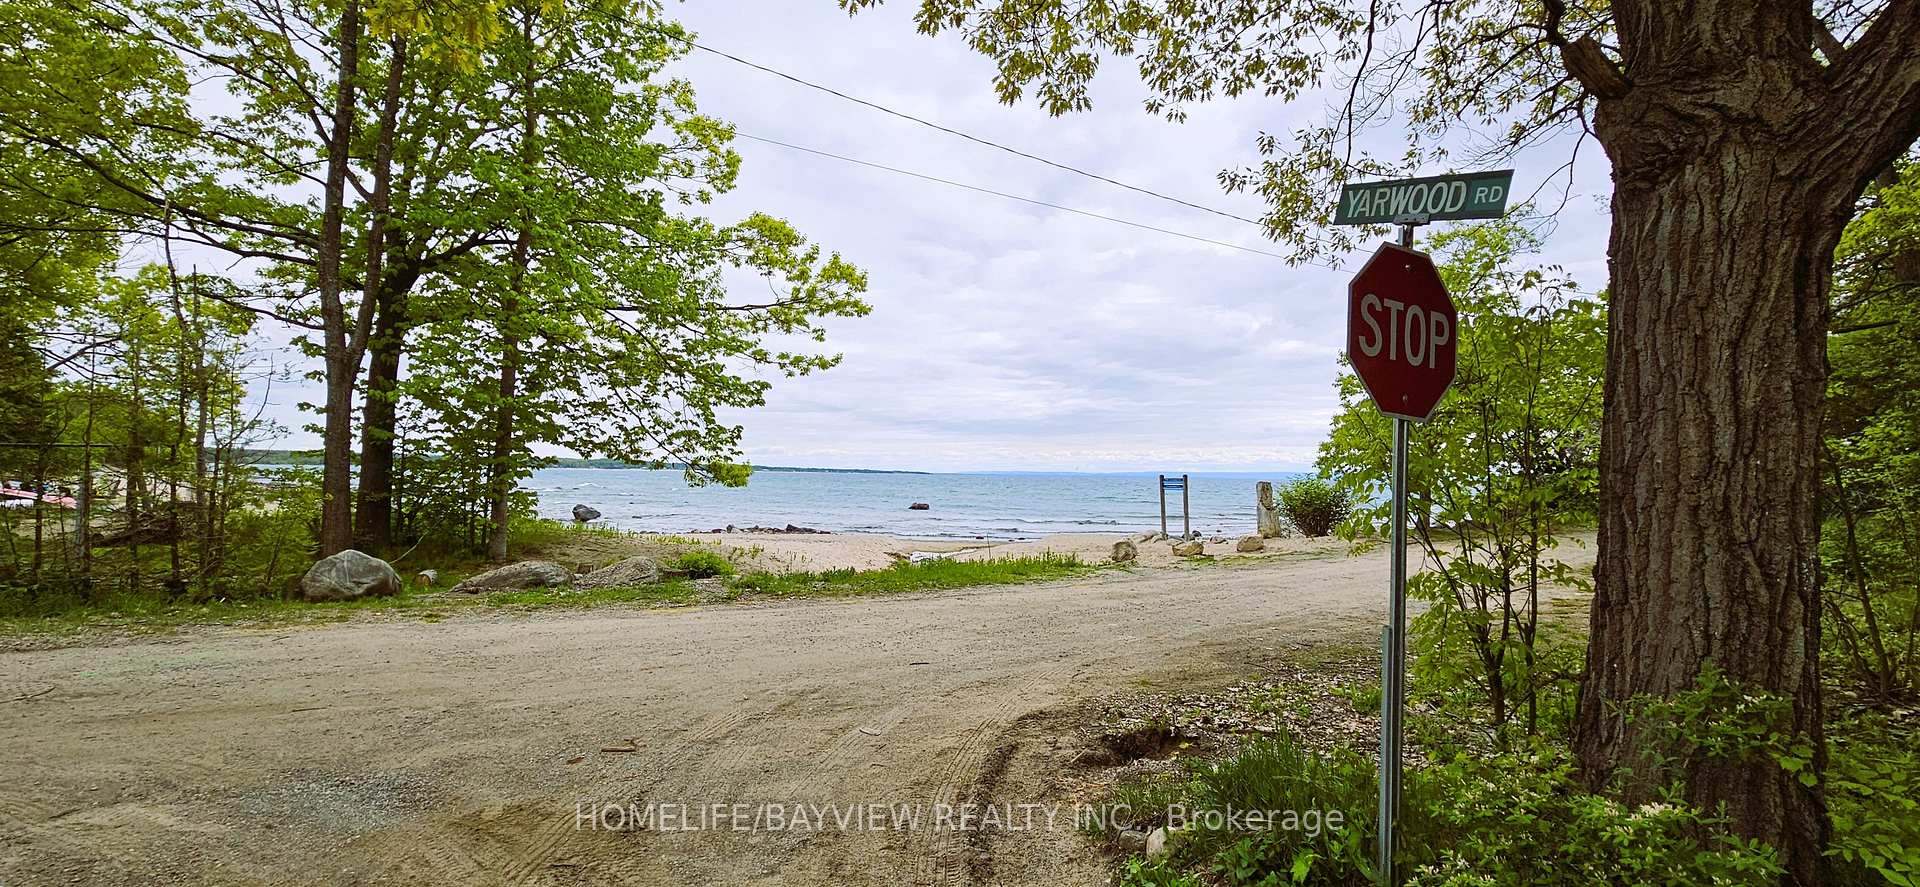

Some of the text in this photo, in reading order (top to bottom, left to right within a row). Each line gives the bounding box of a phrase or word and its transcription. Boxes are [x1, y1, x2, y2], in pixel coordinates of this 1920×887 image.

[1347, 181, 1504, 218] YARWOOD RD
[1358, 293, 1450, 369] STOP
